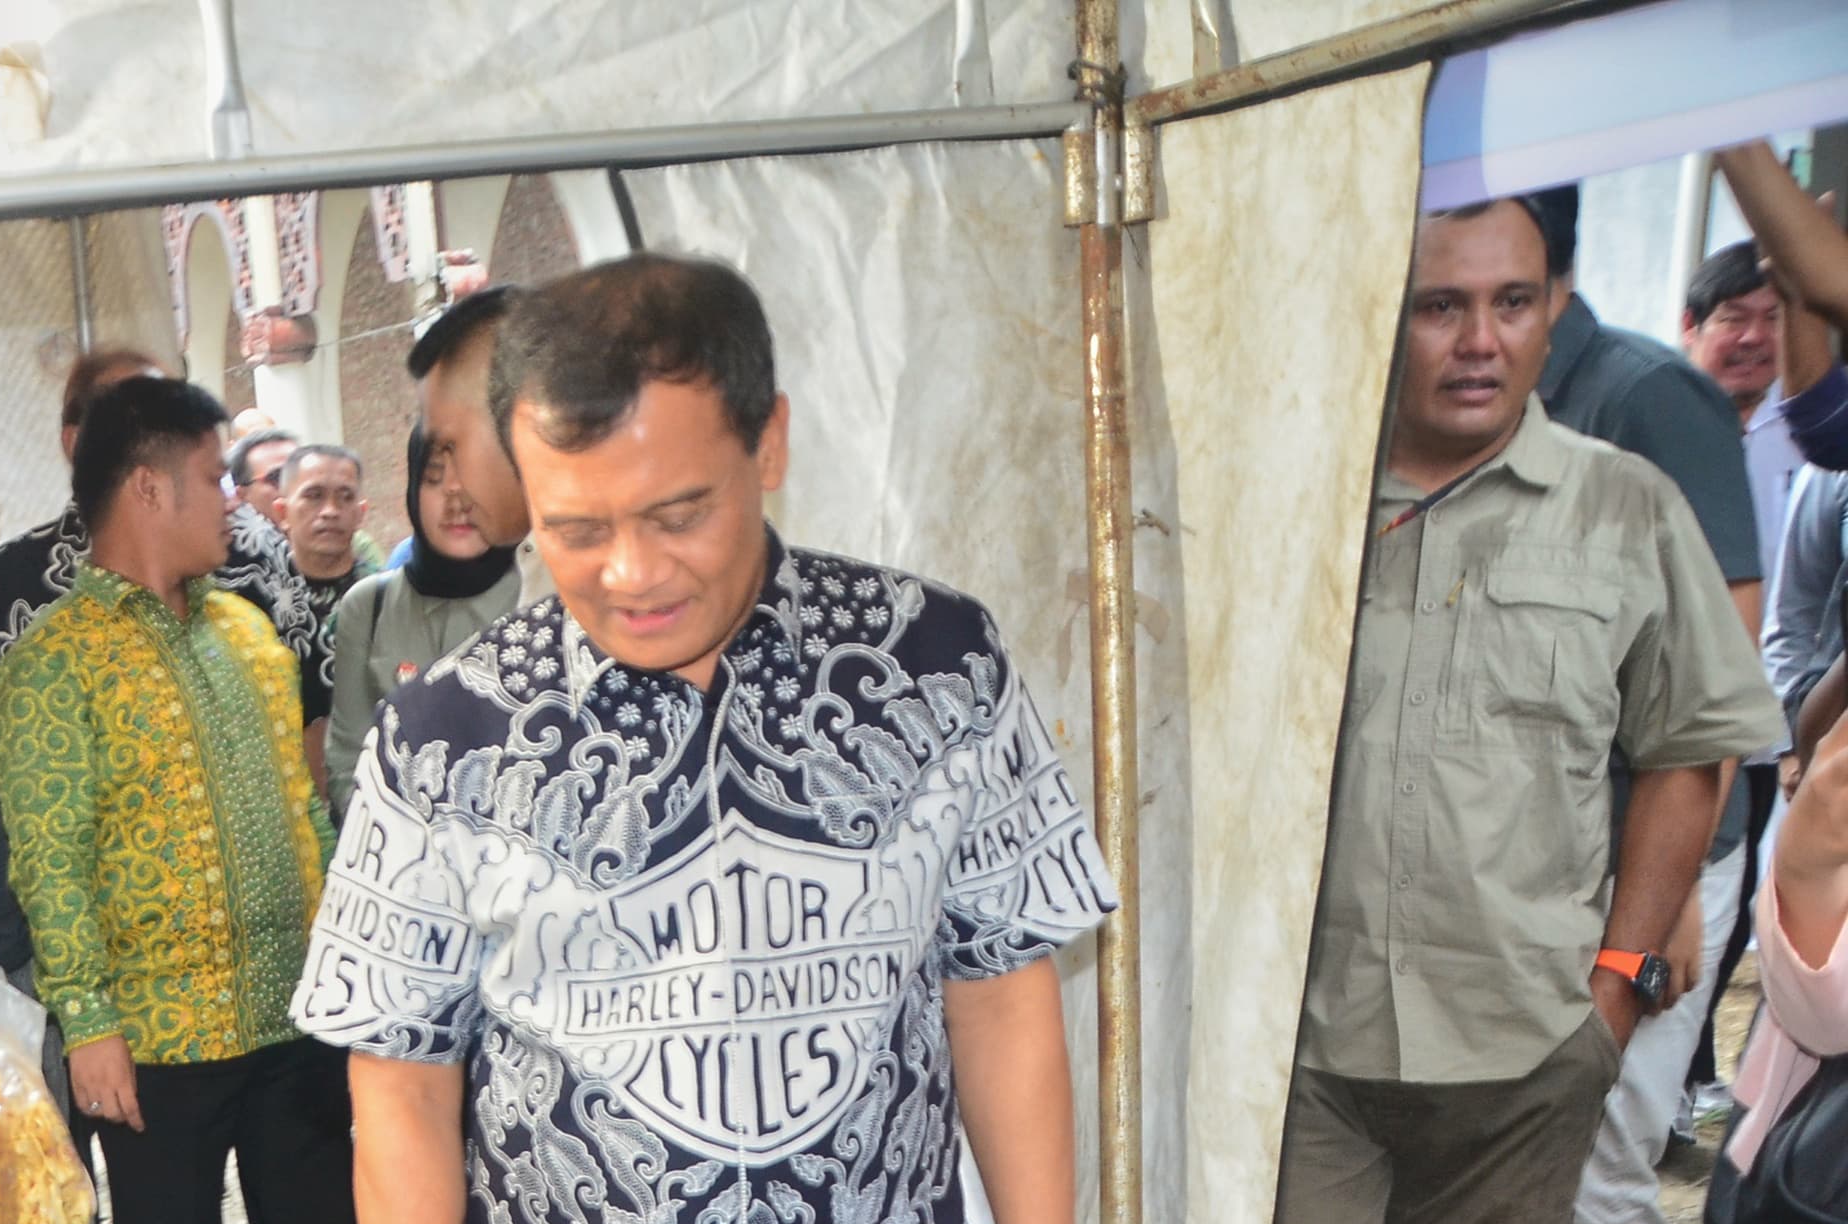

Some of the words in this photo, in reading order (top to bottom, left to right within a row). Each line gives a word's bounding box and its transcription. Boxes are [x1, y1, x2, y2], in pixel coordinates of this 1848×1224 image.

[650, 861, 828, 960] MOTOR
[581, 951, 902, 1028] HARLEY-DAVIDSON
[659, 1025, 840, 1136] CYCLES
